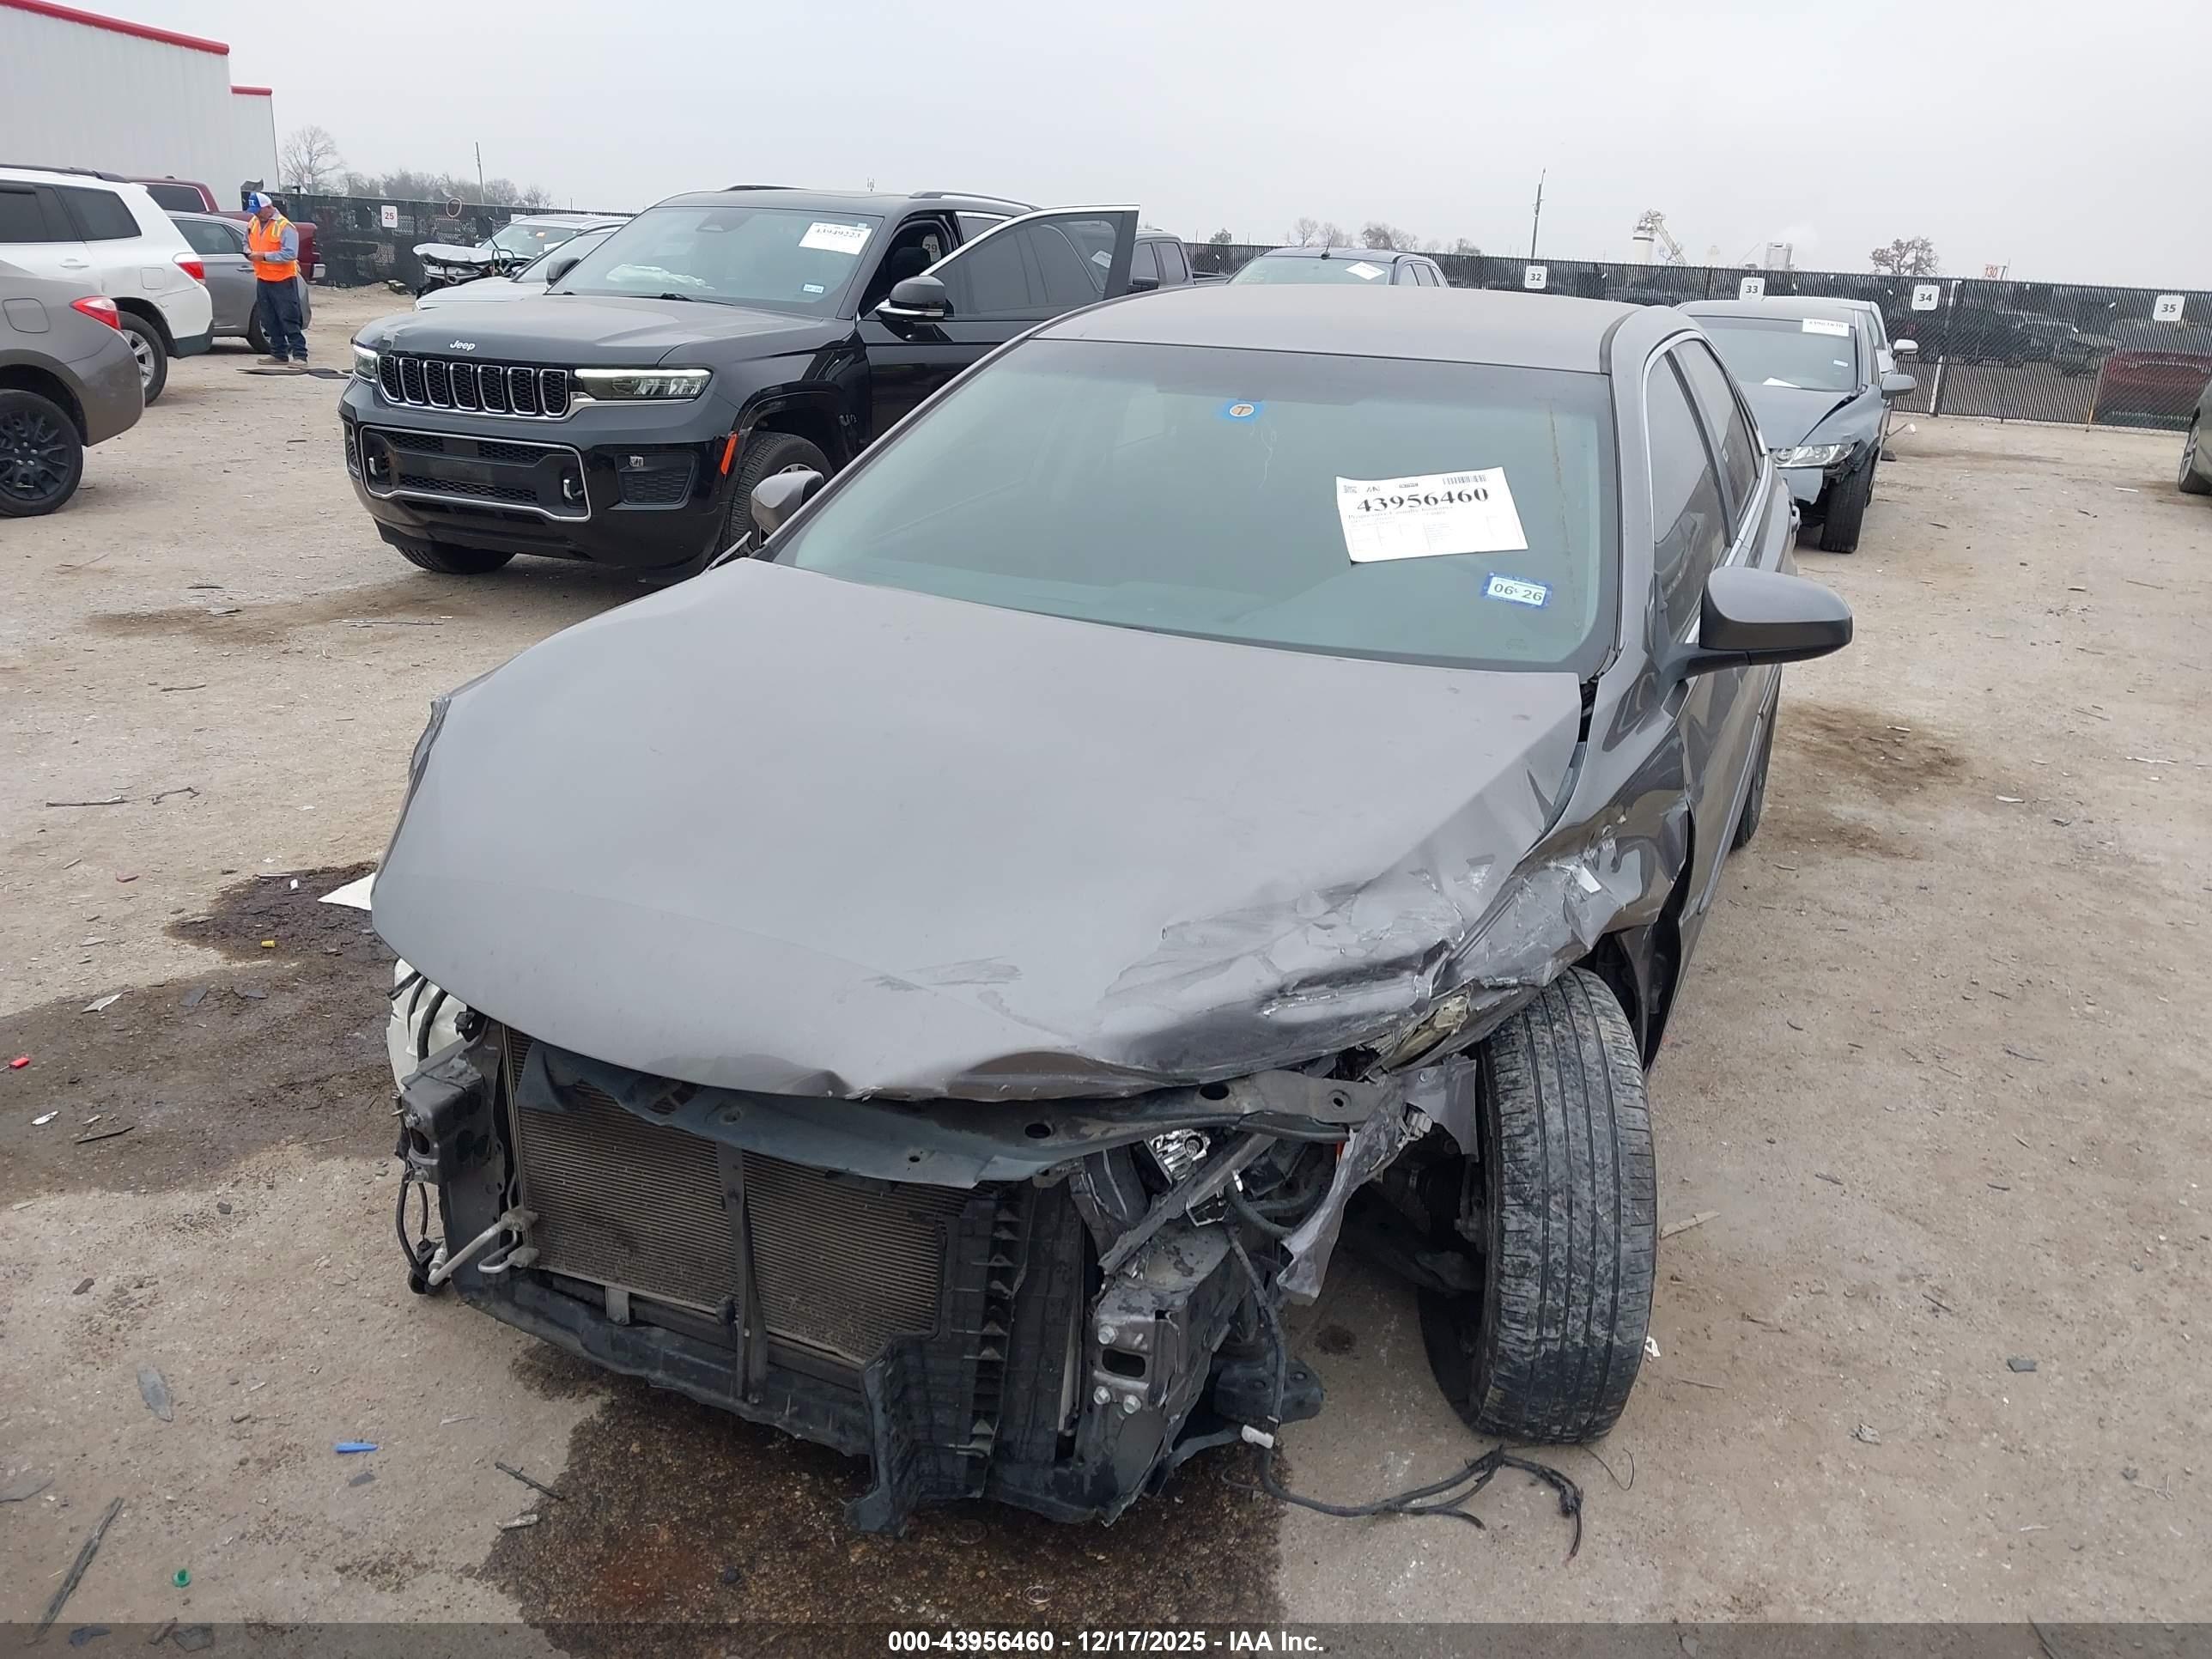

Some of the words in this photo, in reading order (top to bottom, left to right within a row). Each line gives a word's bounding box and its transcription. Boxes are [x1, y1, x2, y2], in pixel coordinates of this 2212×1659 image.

[385, 211, 395, 220] 25
[1530, 273, 1542, 282] 32
[1746, 285, 1759, 294] 33
[1918, 293, 1933, 302] 34
[2161, 303, 2177, 313] 35
[449, 340, 476, 351] Jeep
[1357, 487, 1489, 513] 43956460
[1494, 583, 1514, 595] 06
[1522, 589, 1544, 602] 26
